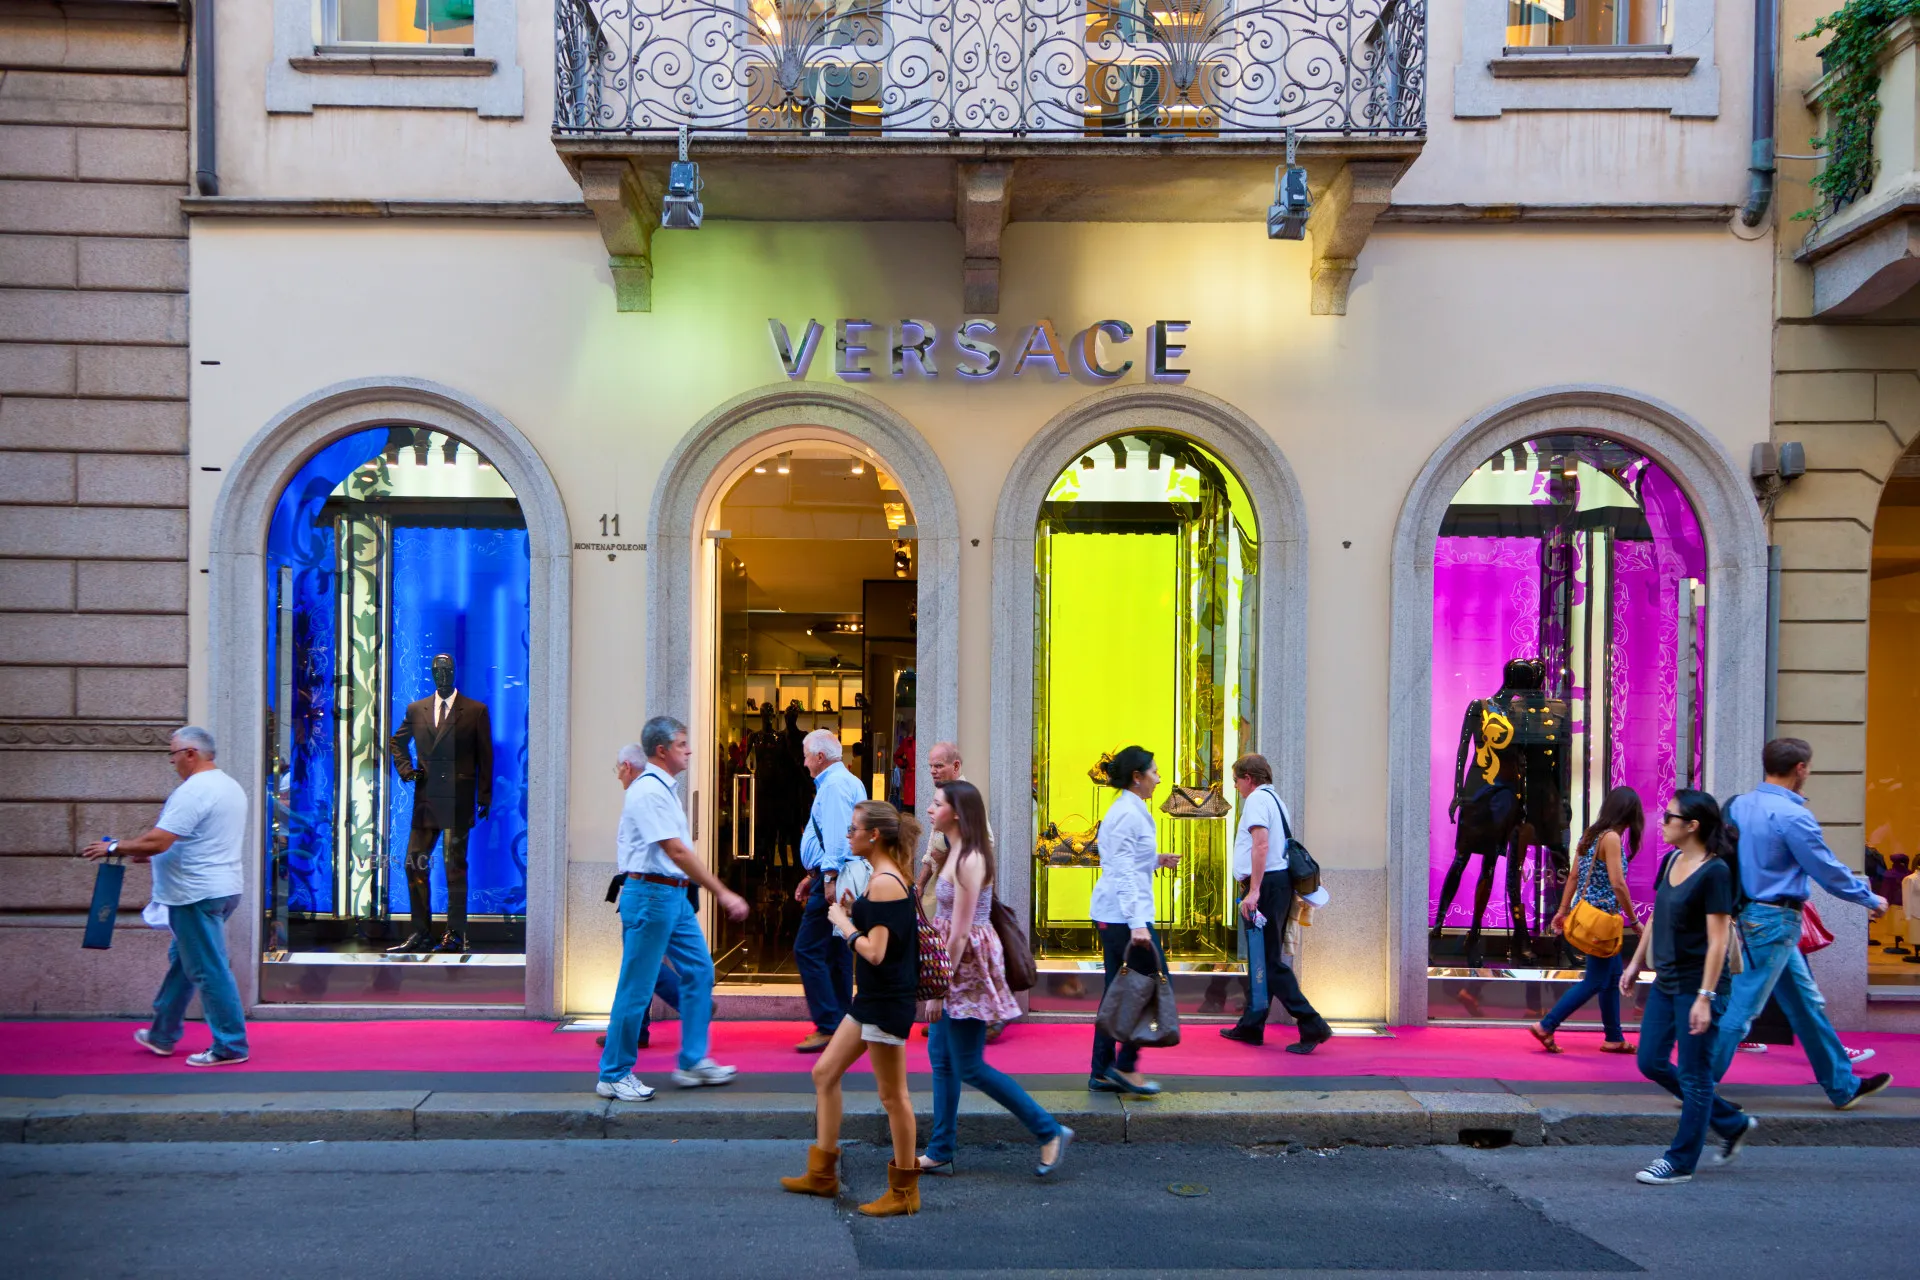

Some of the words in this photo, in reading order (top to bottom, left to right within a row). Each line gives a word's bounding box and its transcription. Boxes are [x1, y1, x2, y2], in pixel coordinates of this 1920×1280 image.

[768, 318, 1191, 378] VERSACE
[599, 513, 620, 537] 11
[574, 543, 648, 551] MONTENAPOLEONE
